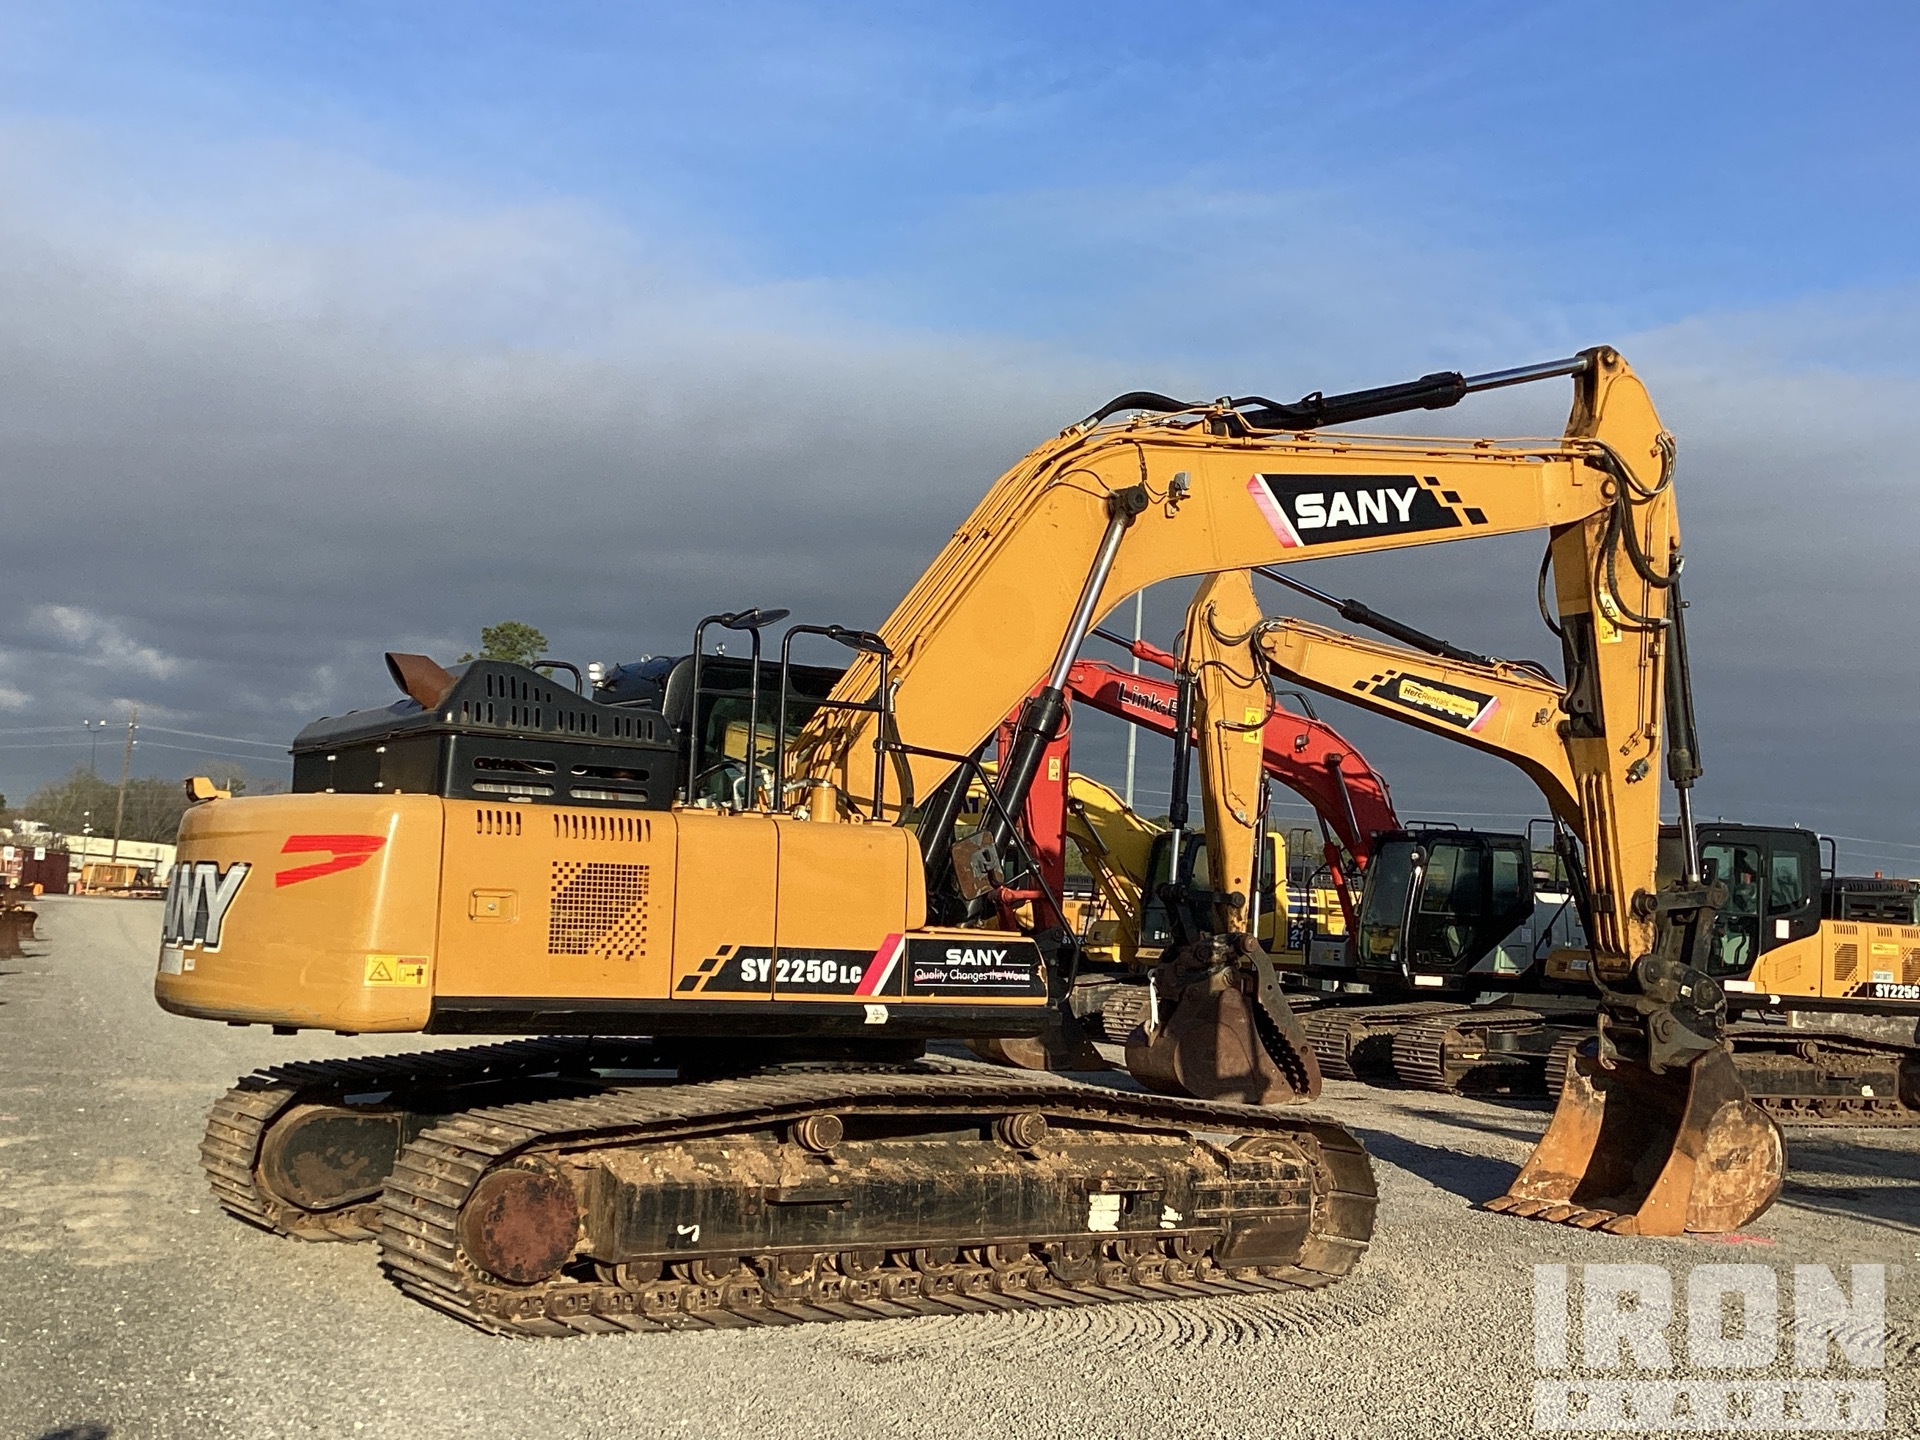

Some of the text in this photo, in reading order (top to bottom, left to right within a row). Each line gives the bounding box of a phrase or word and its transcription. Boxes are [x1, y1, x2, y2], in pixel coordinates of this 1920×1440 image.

[1295, 487, 1417, 529] SANY
[945, 948, 1007, 966] SANY
[914, 968, 948, 983] Quality
[949, 969, 987, 983] Changes
[989, 968, 1003, 980] the
[1875, 983, 1920, 999] SY225C
